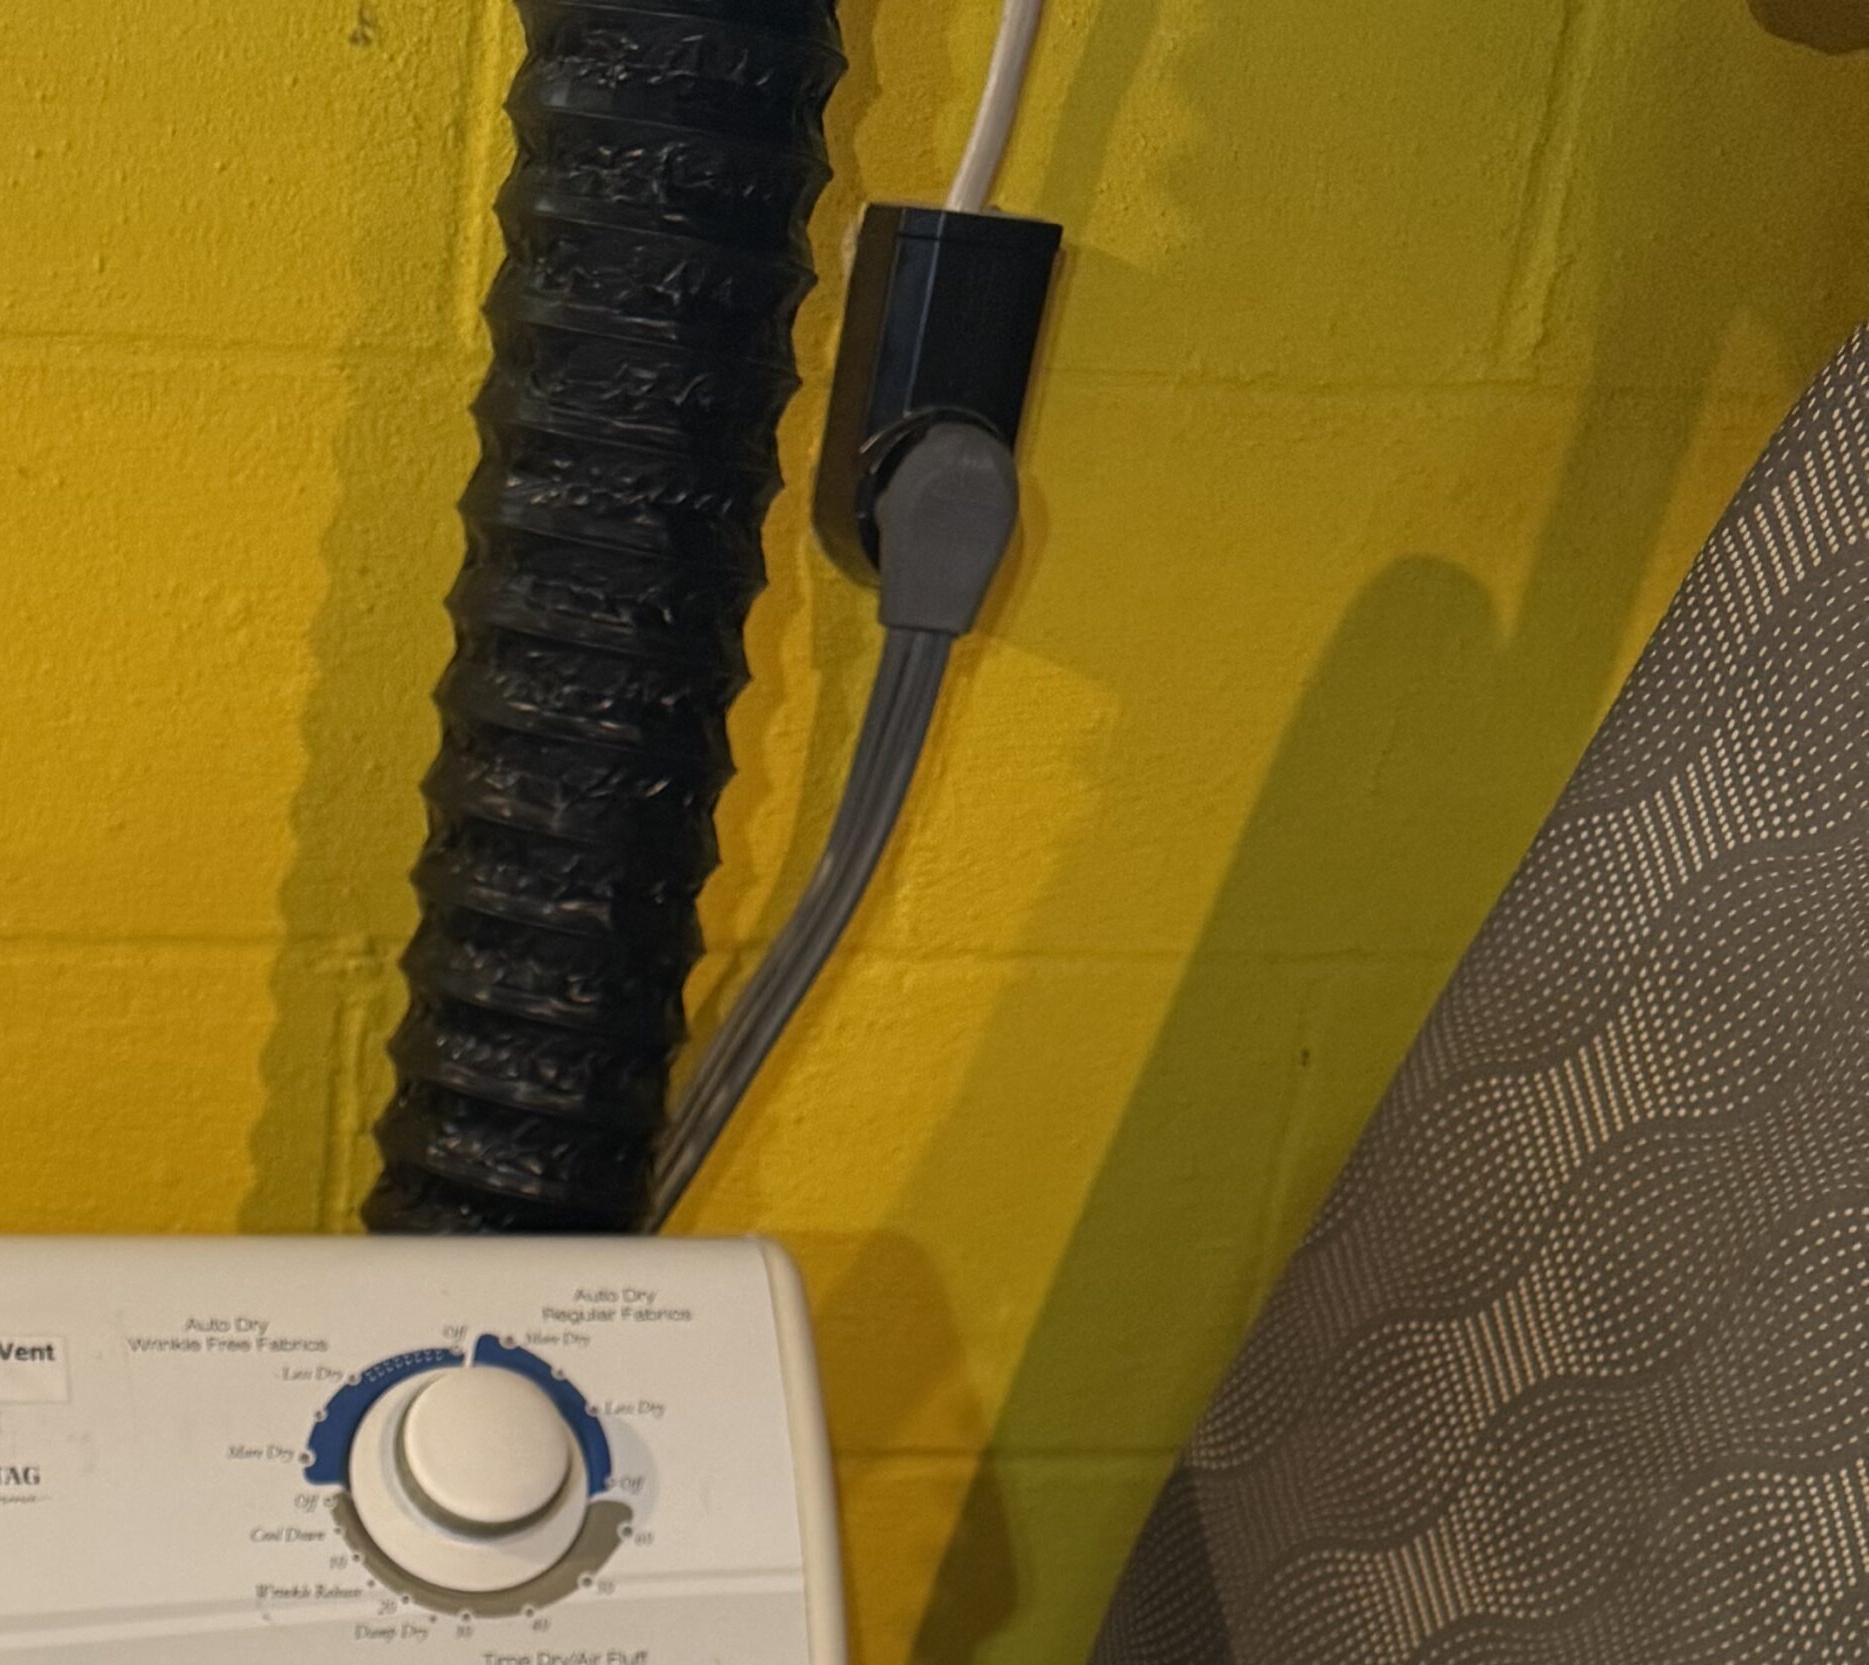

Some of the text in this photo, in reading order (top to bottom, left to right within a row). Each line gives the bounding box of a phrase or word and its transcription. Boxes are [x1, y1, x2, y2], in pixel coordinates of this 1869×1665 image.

[573, 1288, 658, 1305] Auto Dry
[541, 1307, 693, 1325] Regular Fabrics
[184, 1317, 270, 1335] Auto Dry
[127, 1337, 329, 1352] Wrinkle Free Fabrics
[294, 1494, 320, 1512] Off
